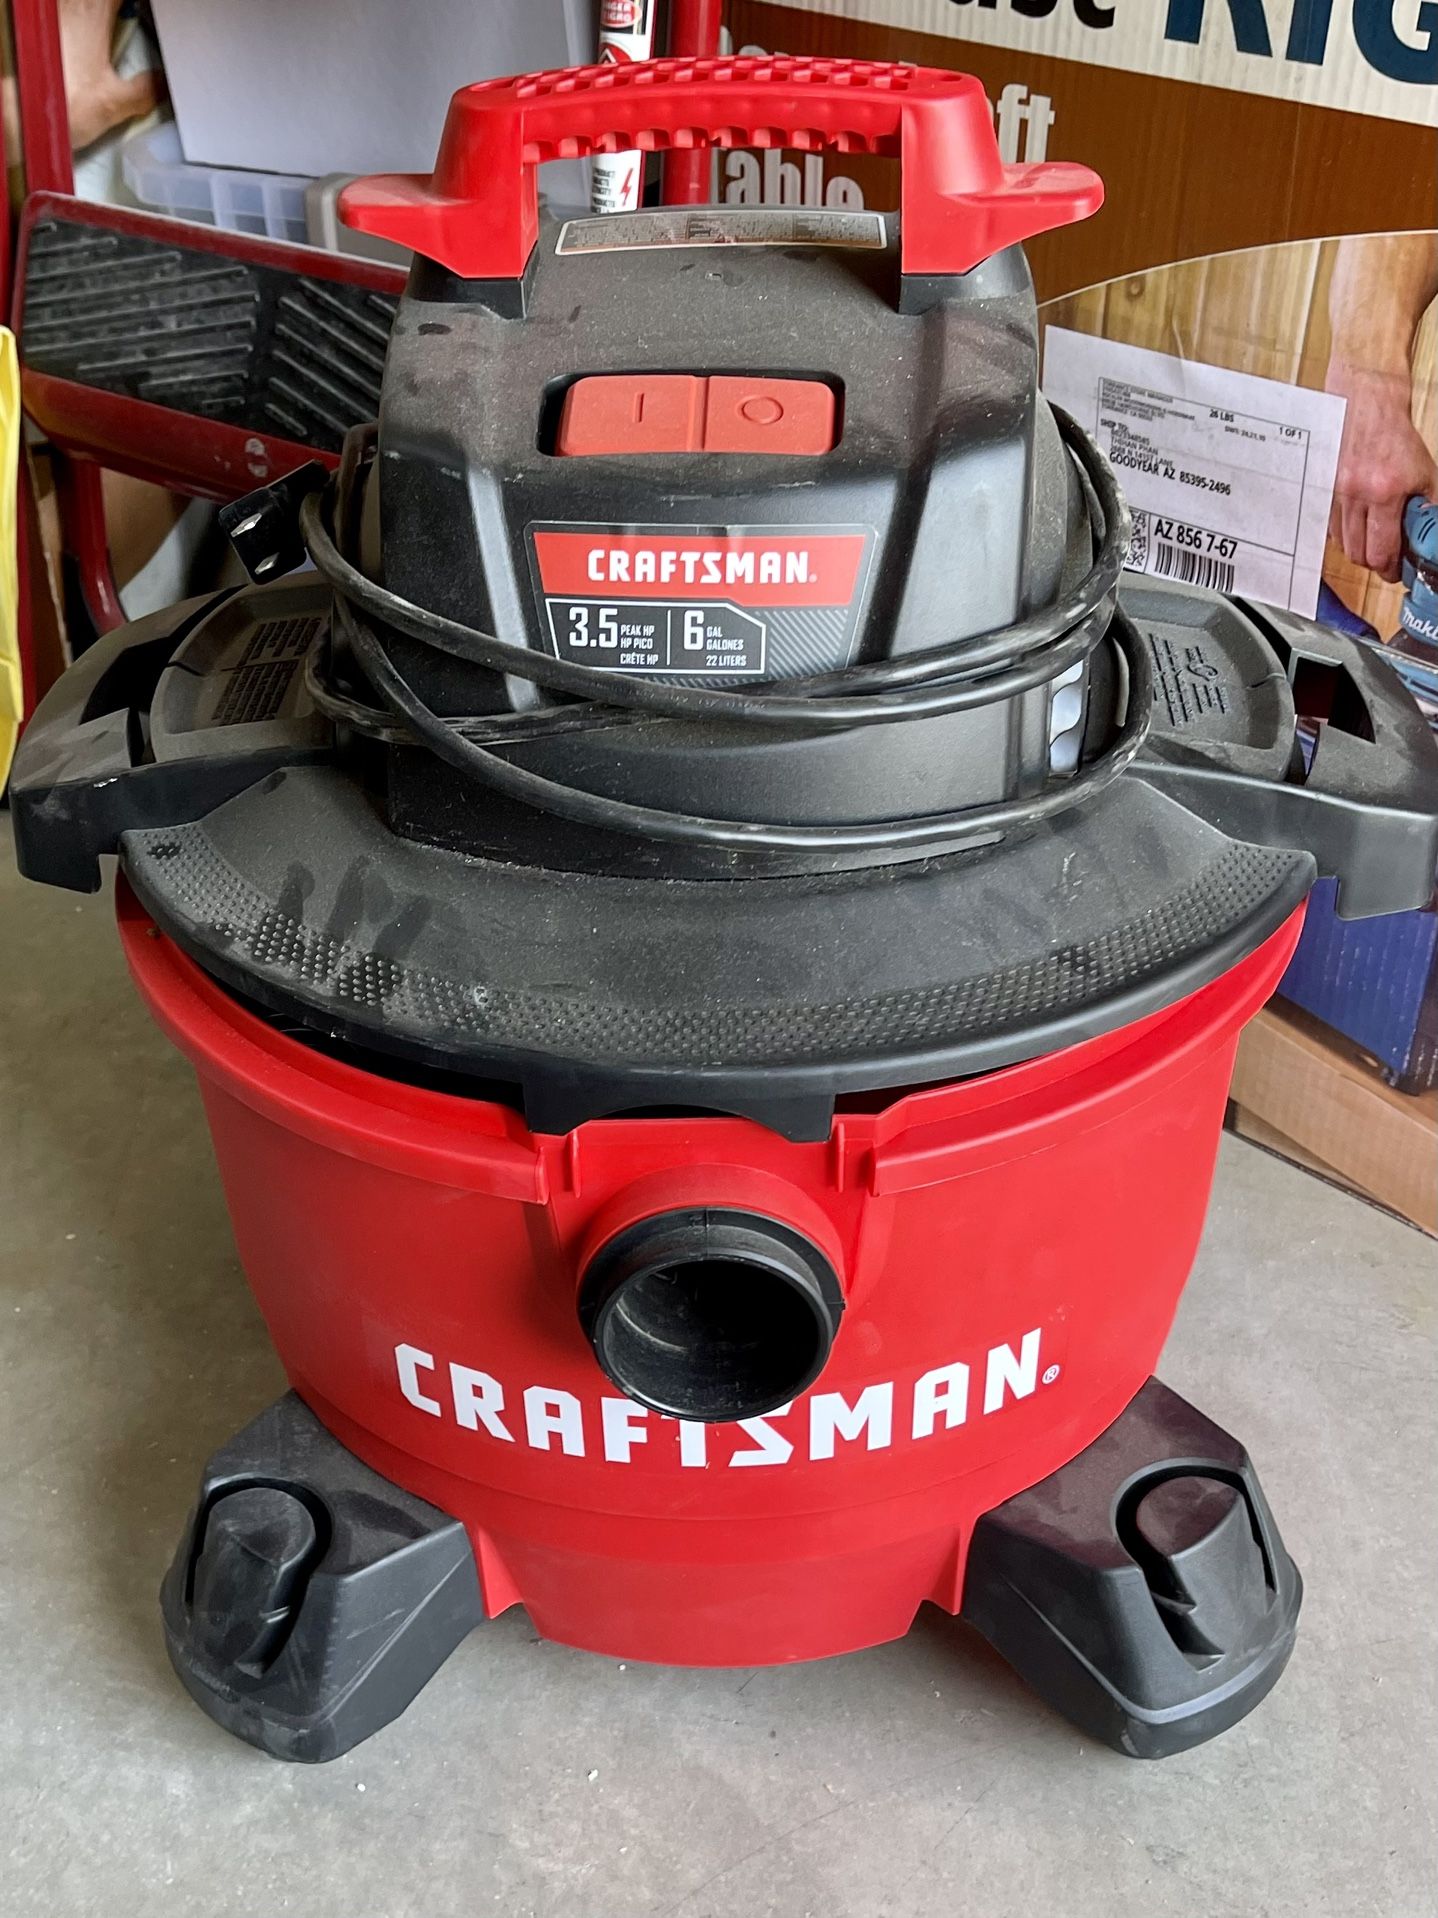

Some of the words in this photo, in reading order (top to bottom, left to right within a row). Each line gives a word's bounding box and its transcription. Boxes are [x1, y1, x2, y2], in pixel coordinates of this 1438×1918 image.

[1220, 411, 1235, 423] LBS
[1284, 428, 1297, 438] OF
[1109, 451, 1160, 475] GOODYEAR
[1163, 467, 1176, 480] AZ
[1179, 471, 1231, 495] 85395-2496
[1154, 518, 1174, 541] AZ
[1176, 525, 1203, 549] 856
[1206, 533, 1238, 559] 7-67
[569, 606, 618, 648] 3.5
[620, 624, 642, 636] PEAK
[643, 625, 655, 636] HP
[683, 610, 704, 650] 6
[706, 626, 723, 638] GAL
[620, 637, 632, 649] HP
[633, 638, 653, 649] PICO
[706, 639, 744, 651] GALONES
[646, 653, 659, 665] HP
[706, 655, 718, 667] 22
[718, 655, 747, 667] LITERS
